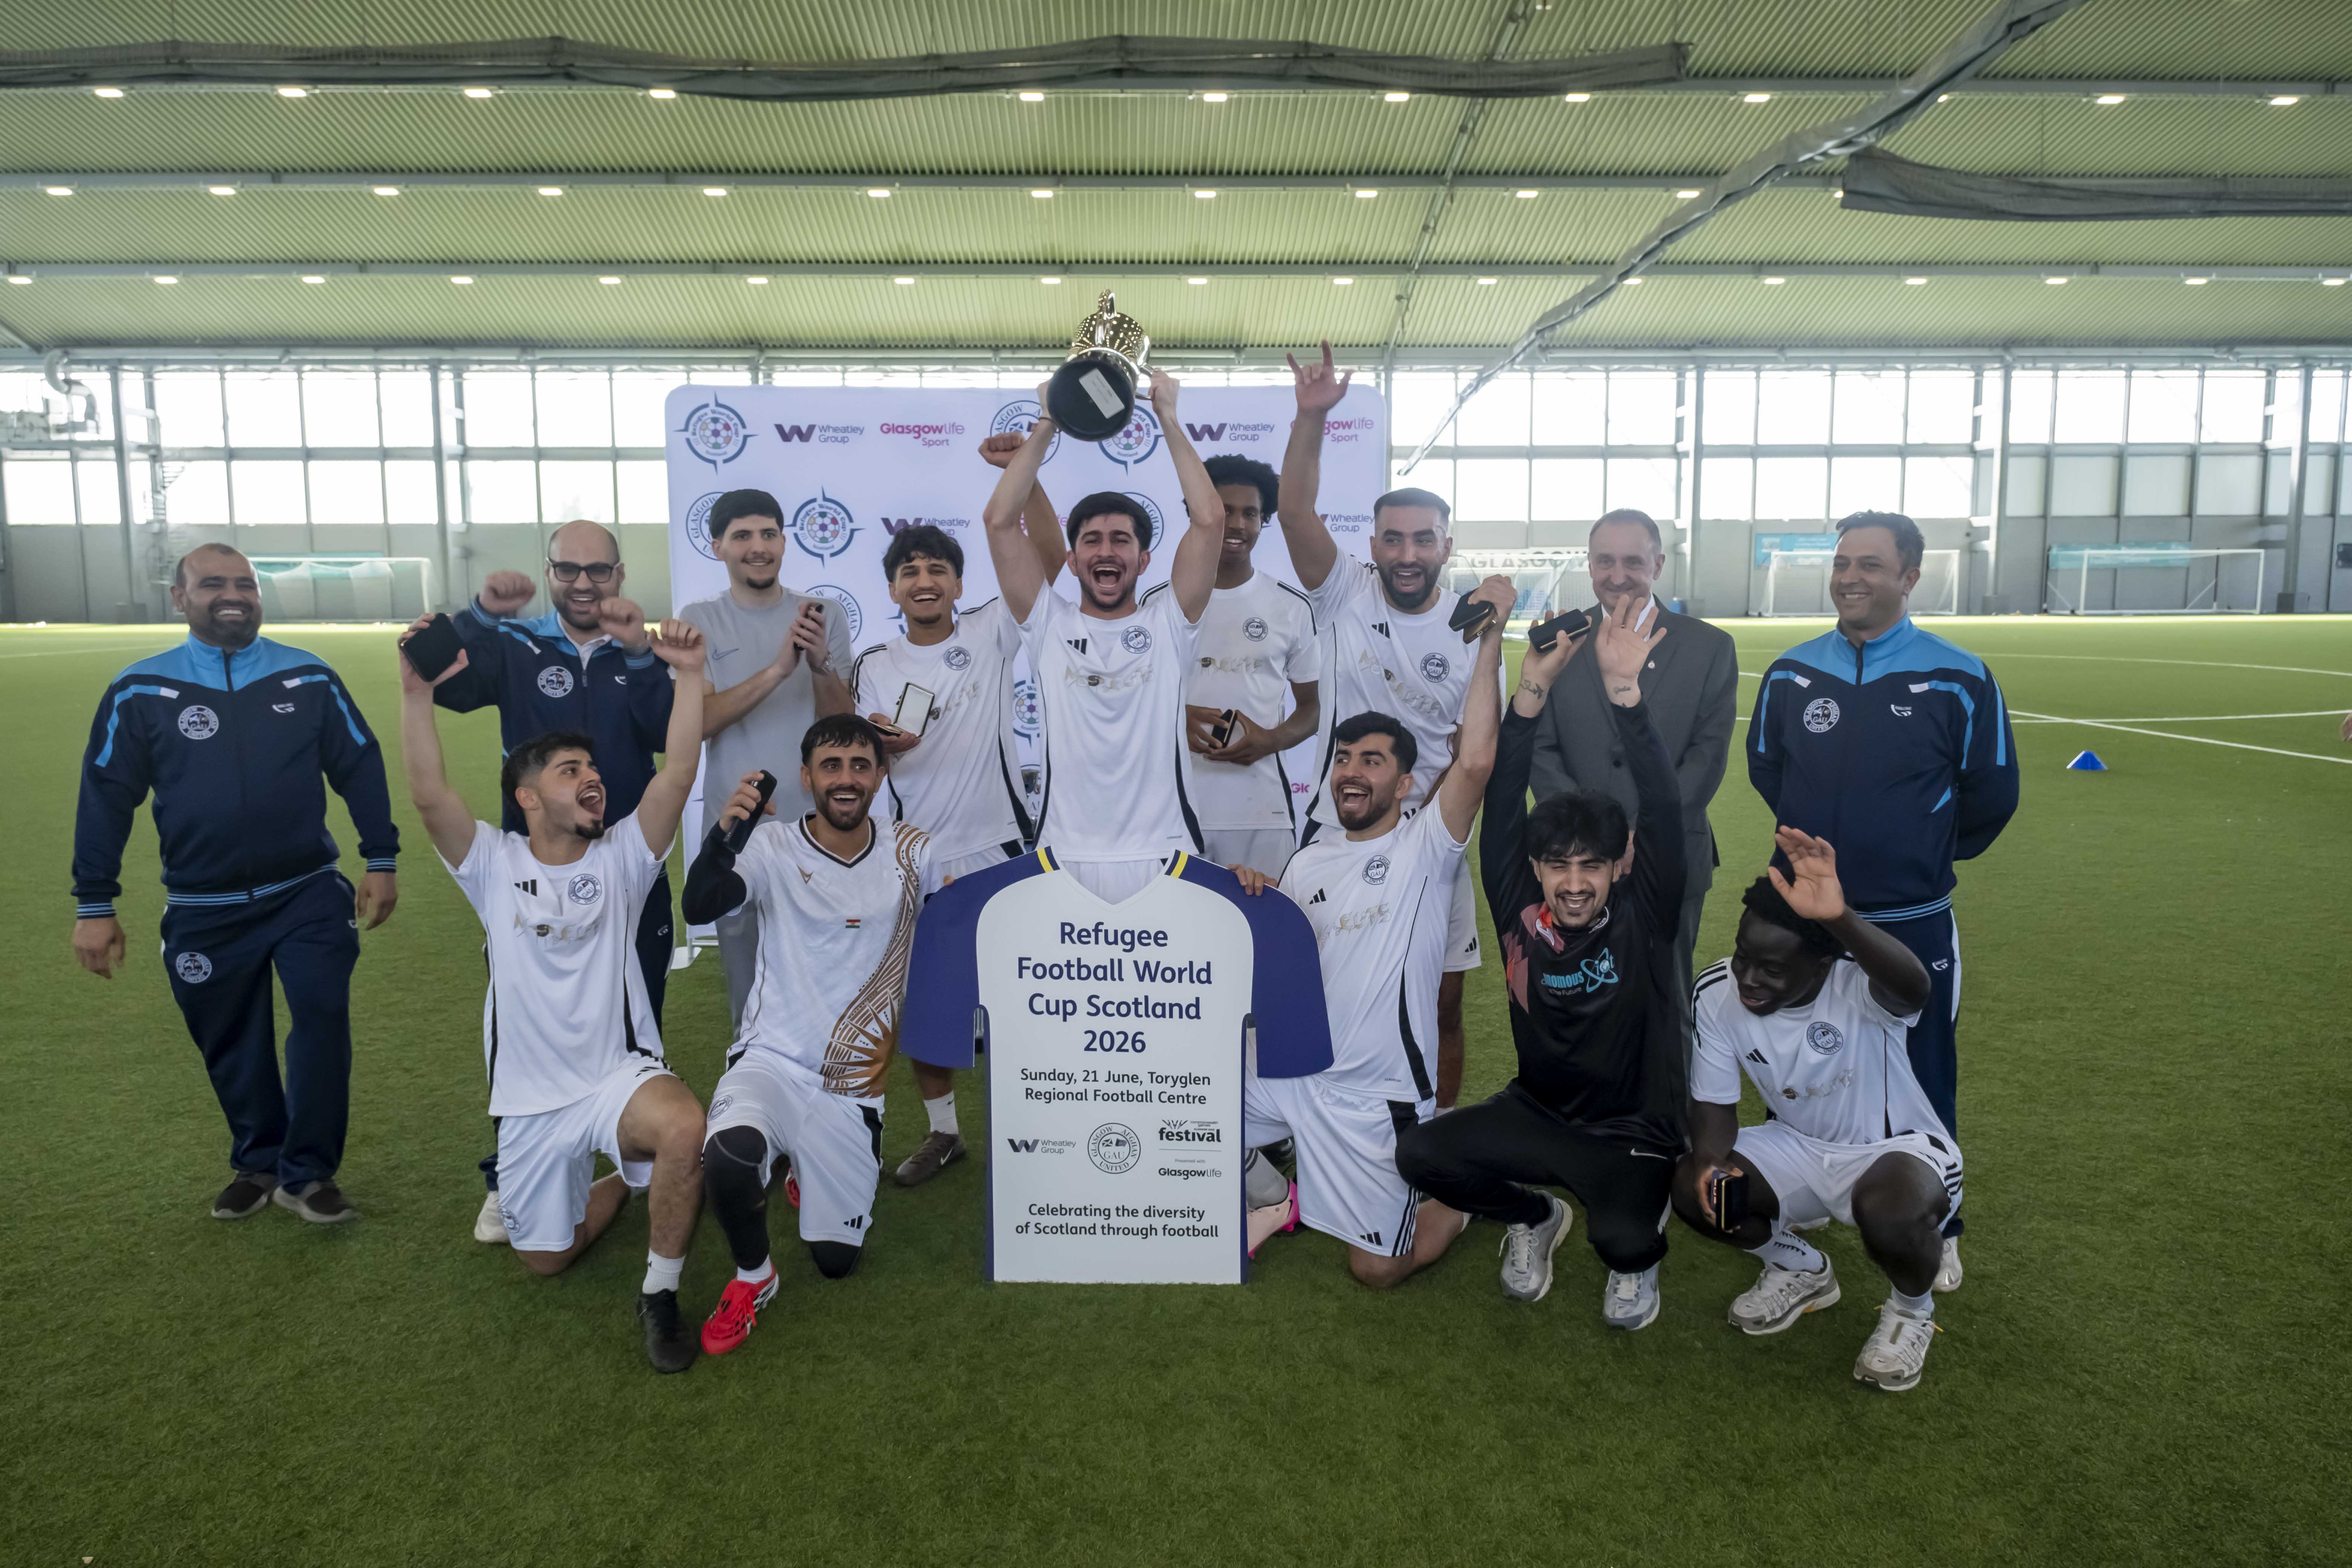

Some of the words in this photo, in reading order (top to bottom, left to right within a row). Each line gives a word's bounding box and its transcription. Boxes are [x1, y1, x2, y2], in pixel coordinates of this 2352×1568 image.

[995, 404, 1023, 433] ASGOW
[818, 425, 864, 435] Wheatley
[880, 423, 965, 439] Glasgowlife
[1229, 423, 1275, 433] Wheatley
[1291, 418, 1374, 435] gowlife
[819, 435, 849, 444] Group
[922, 438, 949, 447] Sport
[1229, 433, 1259, 442] Group
[1331, 434, 1358, 442] Sport
[924, 518, 970, 527] Wheatley
[1330, 514, 1375, 524] Wheatley
[1330, 524, 1360, 533] Group
[835, 593, 858, 631] AFGHAN
[1133, 639, 1144, 648] GAU
[582, 887, 593, 897] GAU
[1060, 922, 1168, 953] Refugee
[1018, 957, 1124, 982] Football
[1133, 960, 1212, 985] World
[1028, 993, 1077, 1022] Cup
[1086, 994, 1201, 1020] Scotland
[1084, 1030, 1146, 1053] 2026
[1821, 1037, 1834, 1047] GAU
[1021, 1068, 1077, 1085] Sunday,
[1082, 1070, 1099, 1082] 21
[1104, 1070, 1143, 1086] June,
[1147, 1072, 1210, 1088] Toryglen
[1025, 1087, 1088, 1104] Regional
[1093, 1089, 1153, 1103] Football
[1158, 1091, 1207, 1104] Centre
[1158, 1127, 1221, 1142] festival
[1041, 1139, 1076, 1148] Wheatley
[1091, 1126, 1113, 1157] GLASGOW
[1121, 1129, 1138, 1159] AFGHAN
[1104, 1151, 1125, 1160] GAU
[1099, 1161, 1129, 1172] UNITED
[1158, 1168, 1222, 1180] Glasgowlife
[1028, 1203, 1111, 1220] Celebrating
[1115, 1205, 1139, 1217] the
[1143, 1205, 1205, 1222] diversity
[1015, 1221, 1030, 1234] of
[1034, 1222, 1097, 1235] Scotland
[1100, 1223, 1158, 1239] through
[1161, 1224, 1219, 1237] football
